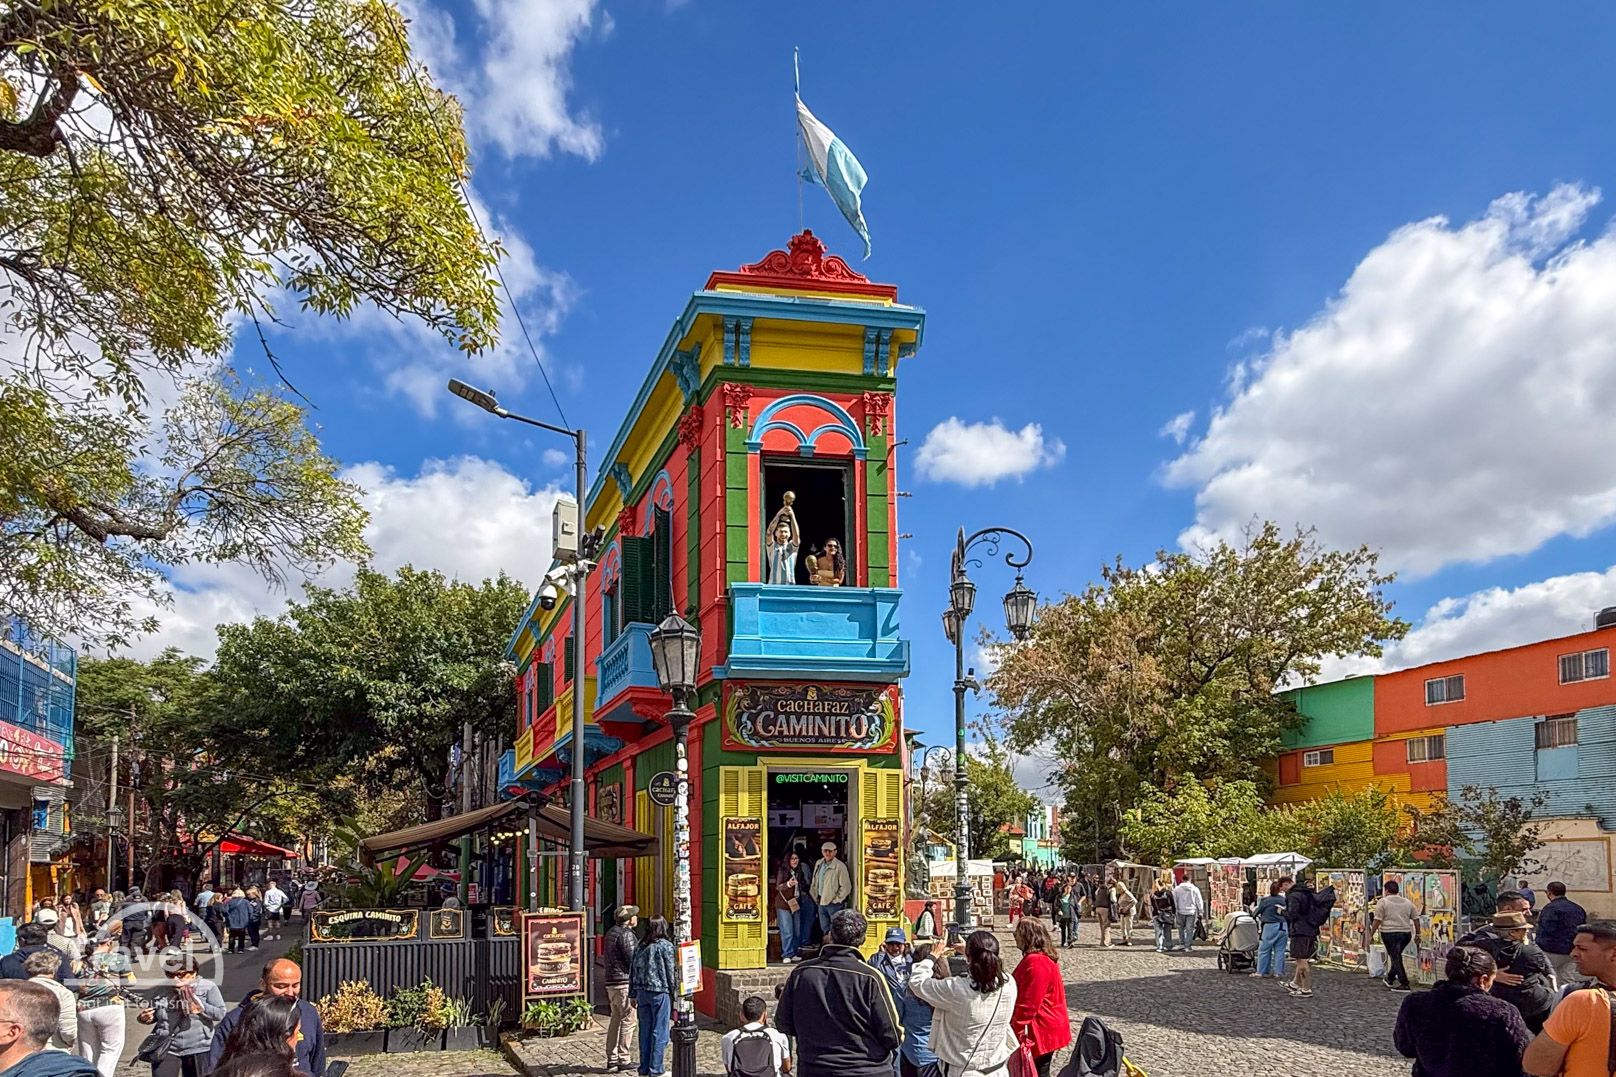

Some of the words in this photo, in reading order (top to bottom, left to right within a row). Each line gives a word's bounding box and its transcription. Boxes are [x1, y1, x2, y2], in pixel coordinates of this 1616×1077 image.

[756, 711, 869, 739] CAMINITO
[776, 774, 848, 784] @VISITCAMINITO
[328, 911, 363, 925] ESQUINA
[365, 910, 402, 923] CAMINITO
